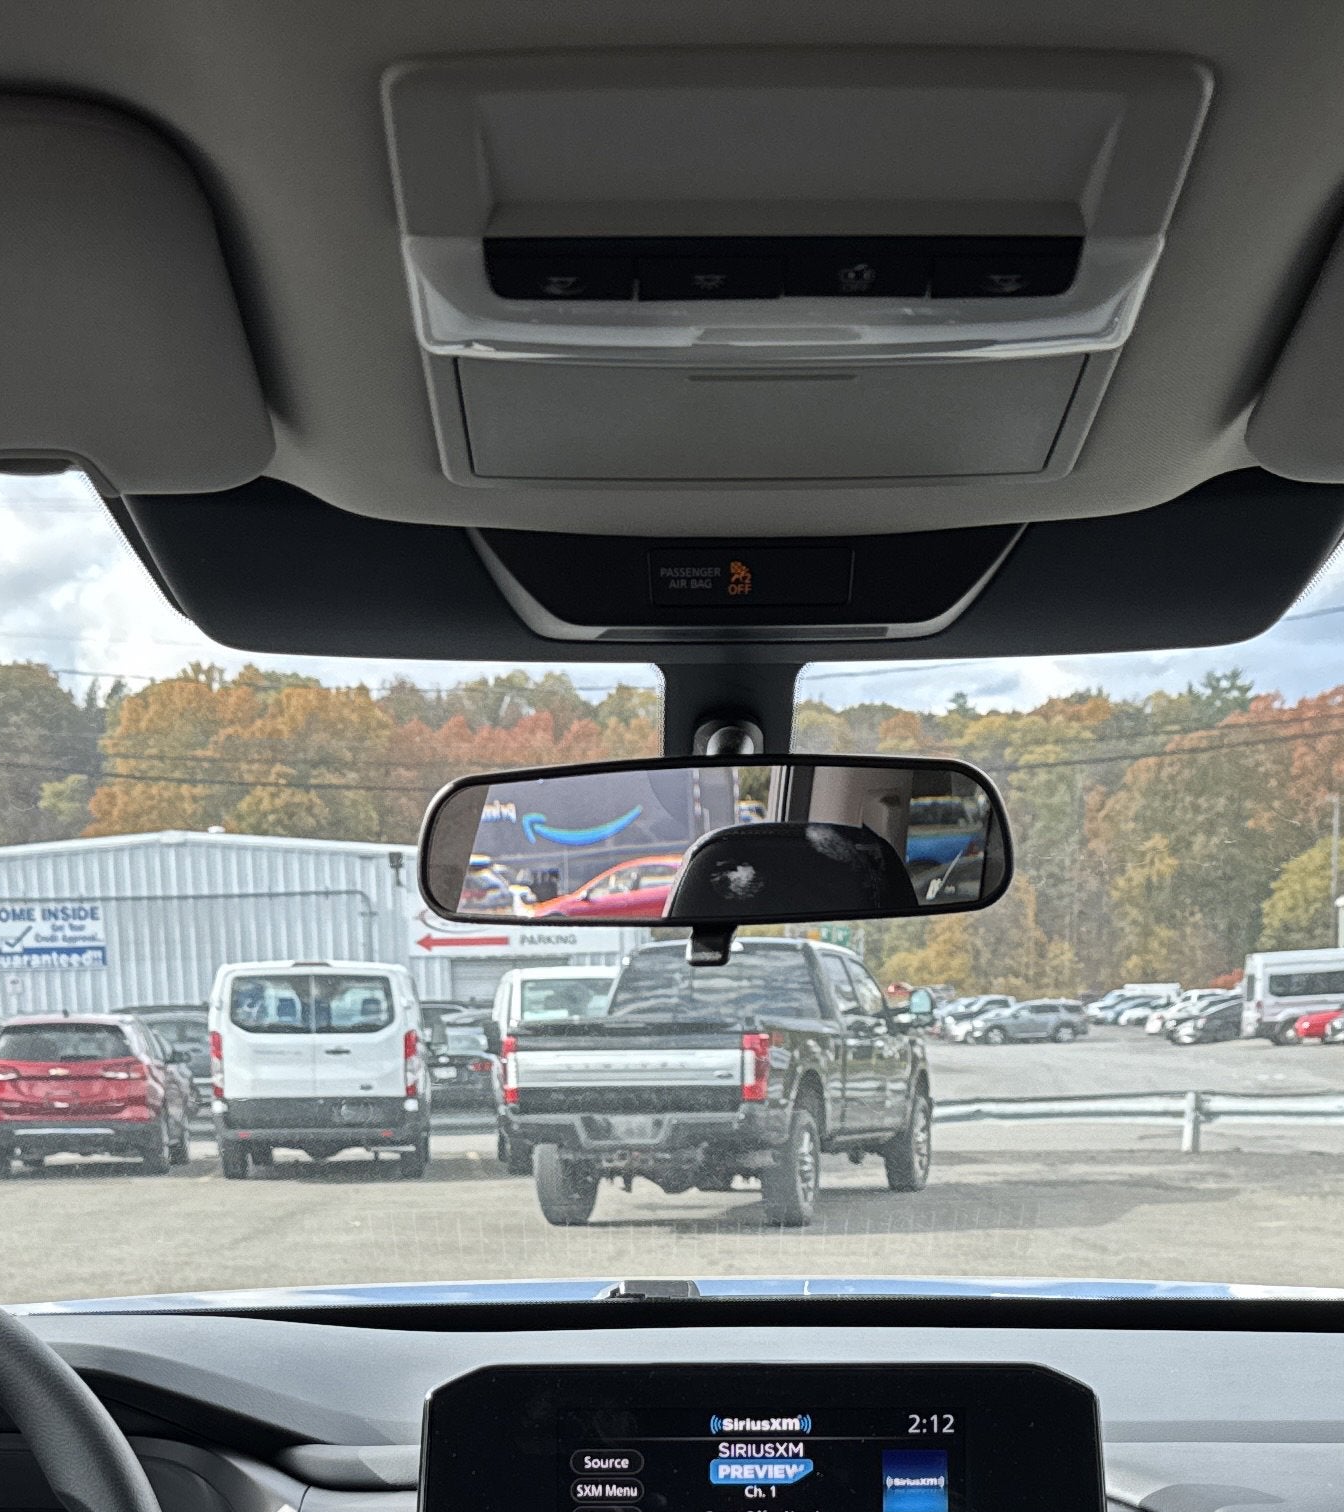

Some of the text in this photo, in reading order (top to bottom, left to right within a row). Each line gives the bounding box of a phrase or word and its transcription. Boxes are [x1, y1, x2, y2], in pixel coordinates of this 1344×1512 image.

[660, 567, 721, 578] PASSENGER
[669, 579, 712, 589] AIR BAG
[728, 584, 752, 595] OFF
[41, 906, 100, 921] INSIDE
[519, 934, 577, 946] PARKING
[908, 1414, 955, 1434] 2:12
[718, 1443, 804, 1458] SIRIUSXM
[584, 1455, 630, 1469] Source
[717, 1464, 805, 1479] PREVIEW
[576, 1484, 638, 1497] SXM Menu
[744, 1485, 777, 1498] Ch. 1
